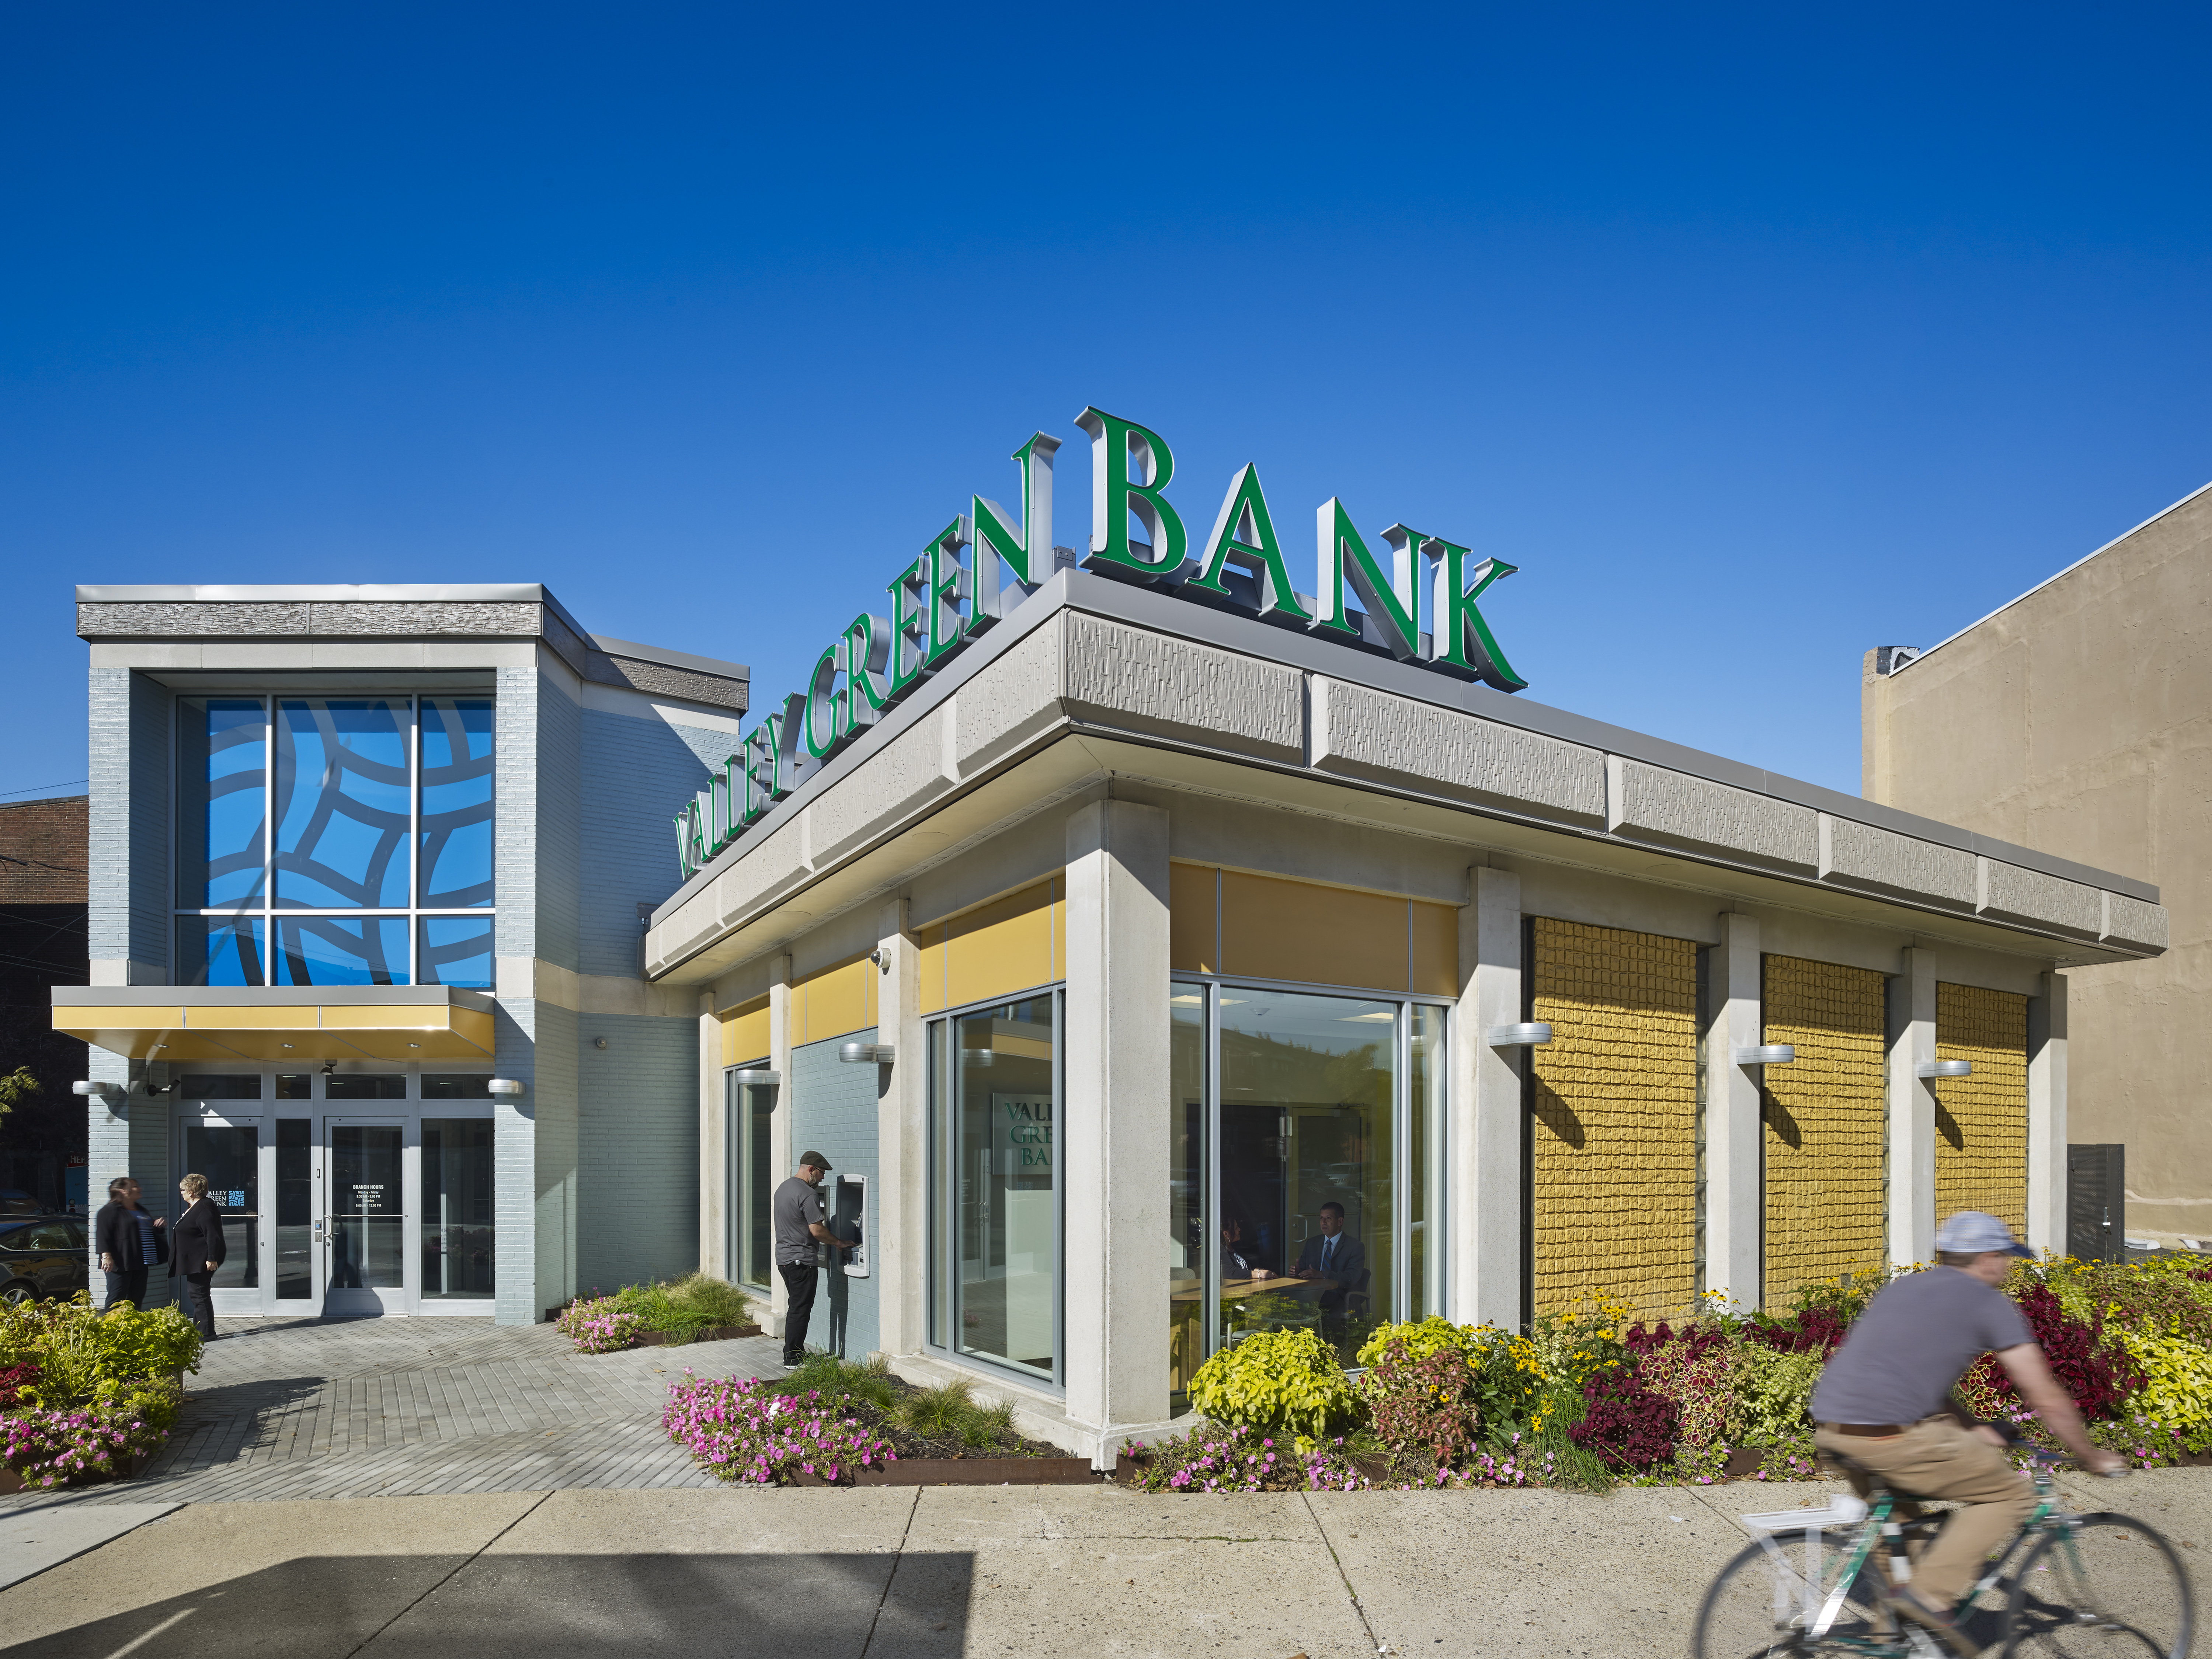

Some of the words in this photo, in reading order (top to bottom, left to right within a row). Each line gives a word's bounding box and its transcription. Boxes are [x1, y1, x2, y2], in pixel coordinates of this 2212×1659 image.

[674, 692, 807, 881] VALLEY
[805, 430, 1062, 759] GREEN
[1074, 406, 1529, 693] BANK
[70, 1155, 88, 1164] HER
[1021, 1147, 1053, 1165] BA
